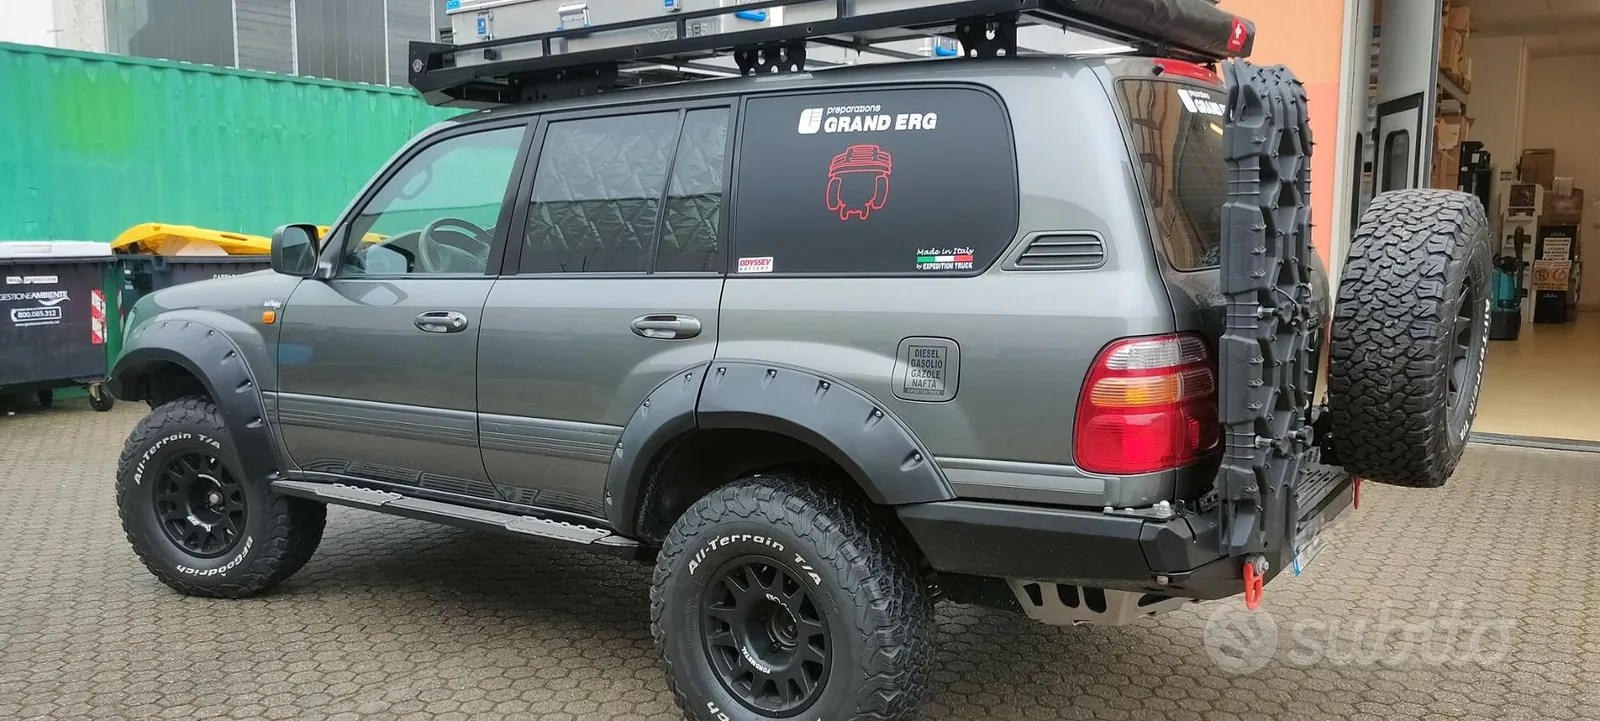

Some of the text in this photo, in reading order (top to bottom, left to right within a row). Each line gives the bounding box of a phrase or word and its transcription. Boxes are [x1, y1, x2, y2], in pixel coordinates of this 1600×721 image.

[826, 104, 881, 115] preparazione
[824, 112, 938, 133] GRAND ERG
[916, 247, 940, 255] Made
[953, 246, 974, 255] Italy
[923, 262, 954, 270] EXPEDITION
[955, 262, 973, 270] TRUCK
[915, 348, 940, 358] DIESEL
[911, 358, 943, 369] GASOLIO
[911, 369, 941, 379] GAZOLE
[912, 379, 937, 388] NAFTA
[133, 432, 221, 486] All-Terrain T/A
[687, 534, 822, 586] All-Terrain T/A
